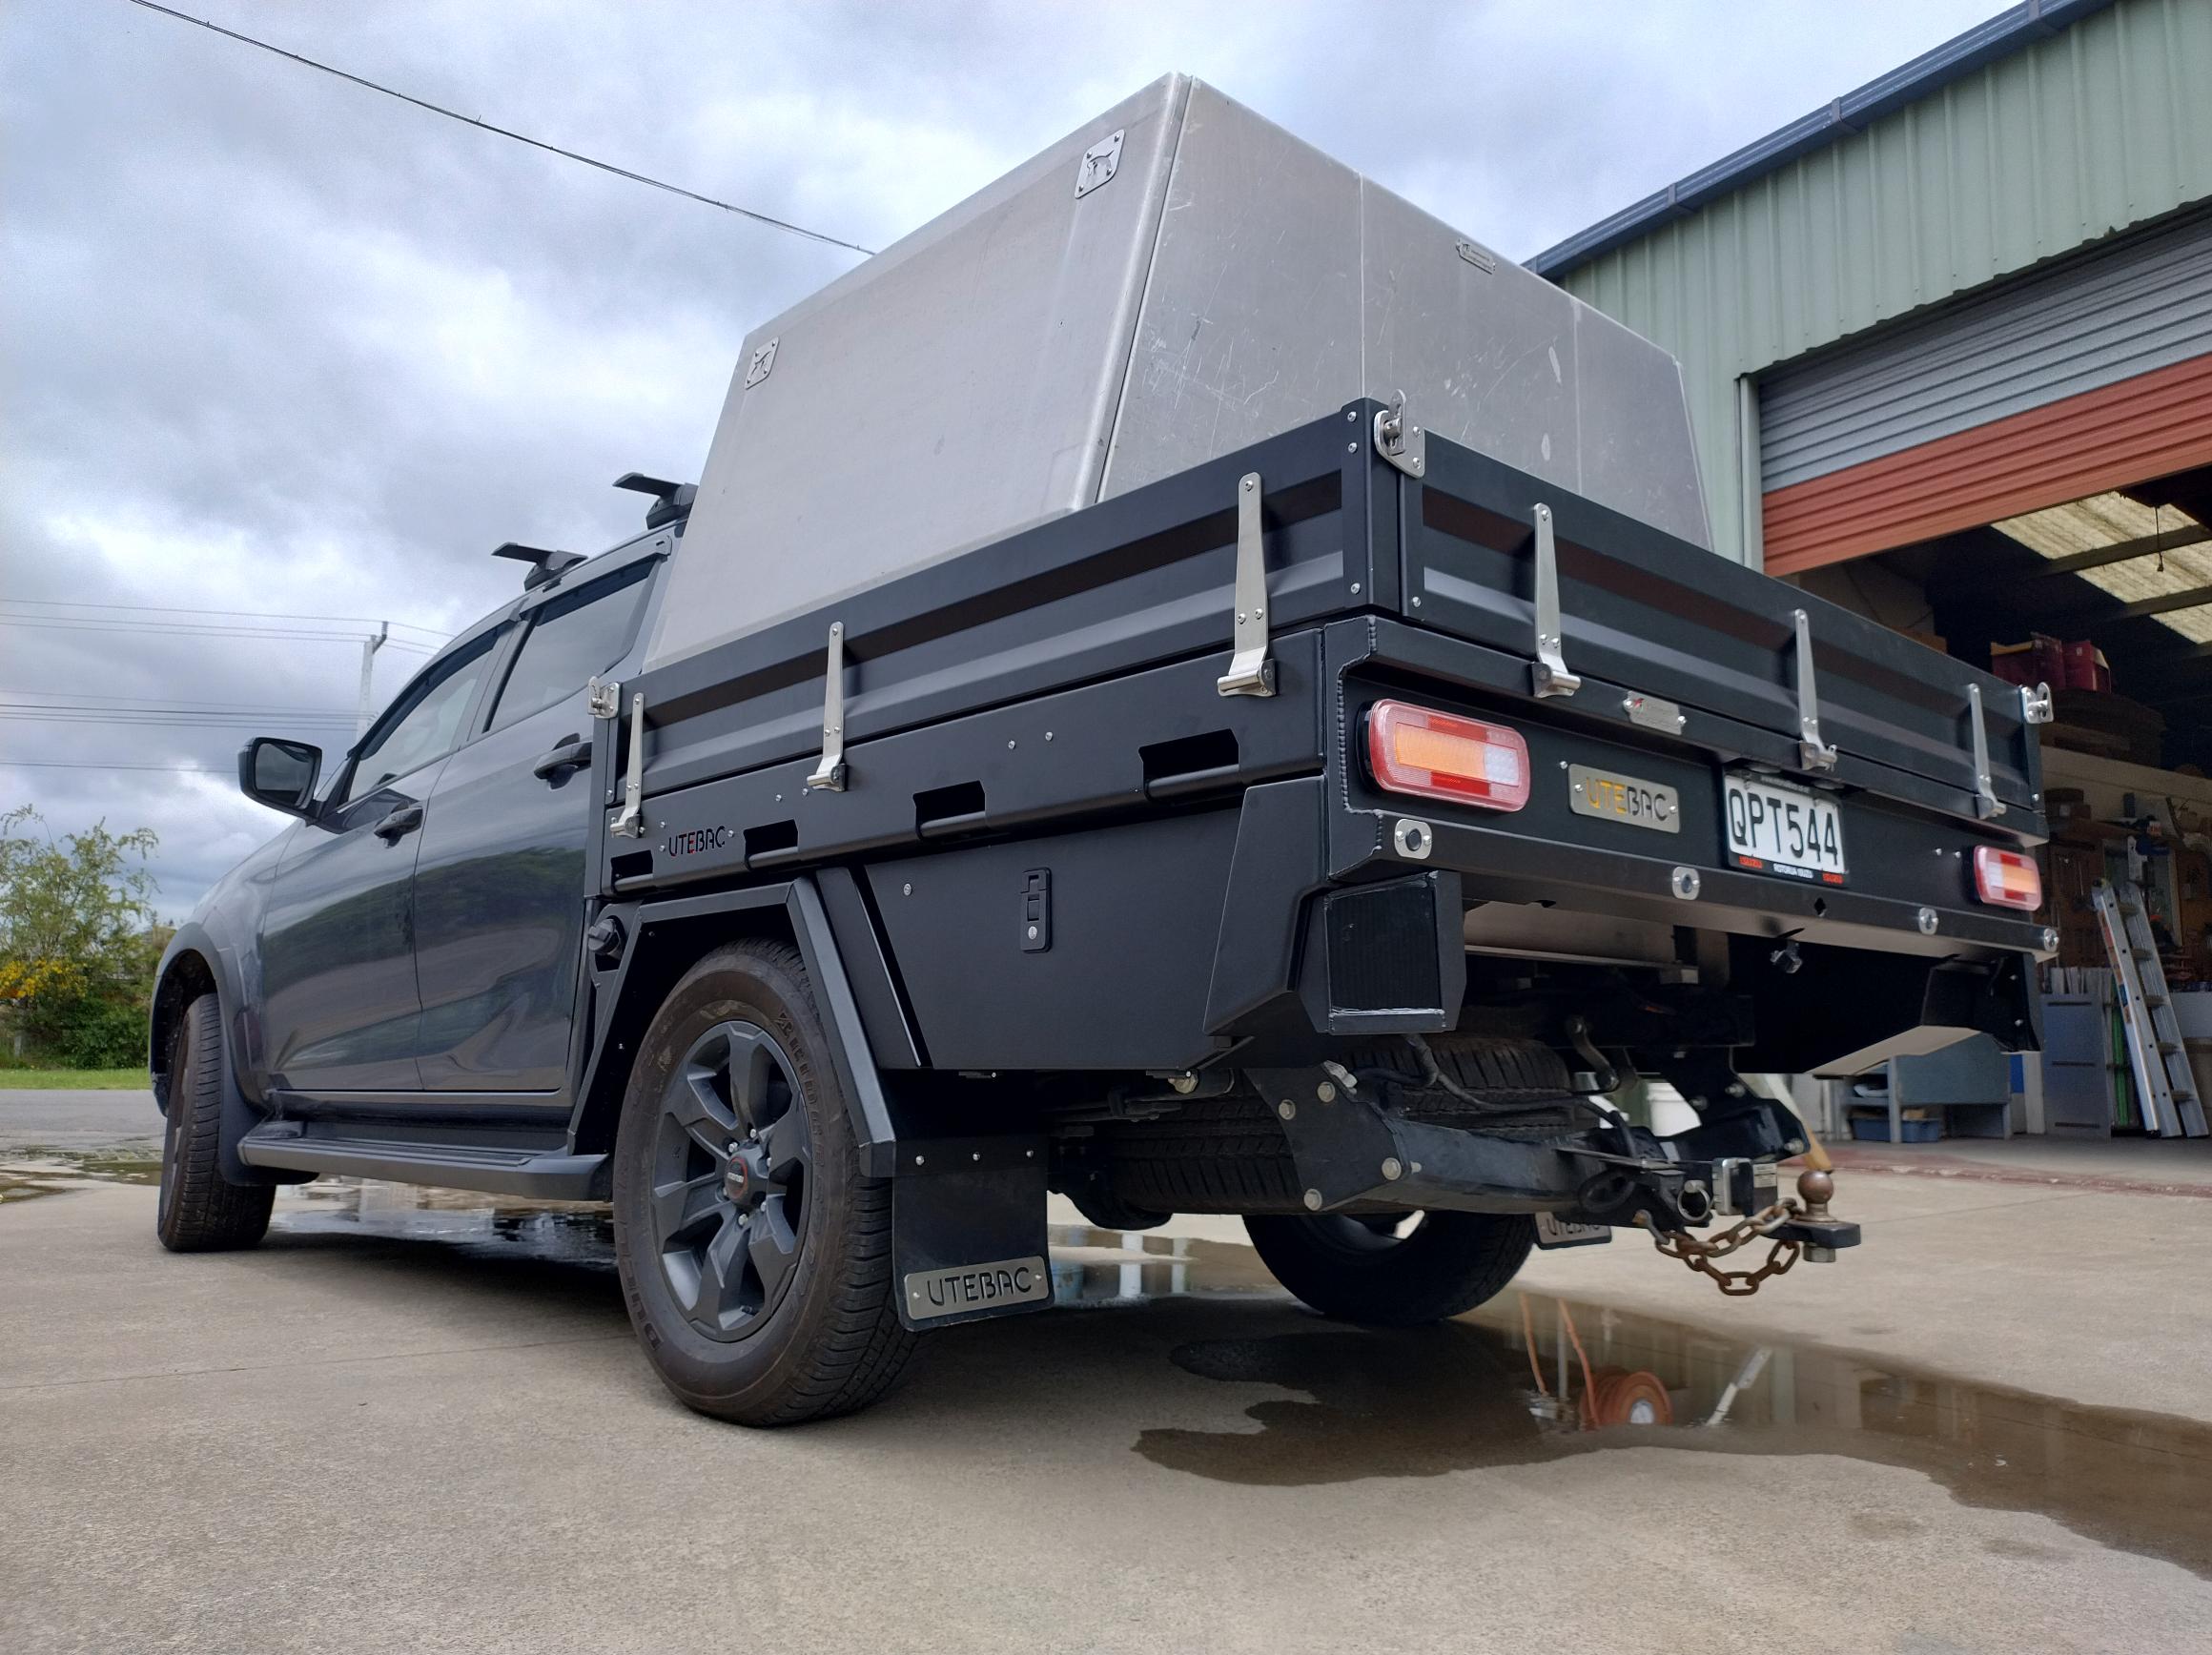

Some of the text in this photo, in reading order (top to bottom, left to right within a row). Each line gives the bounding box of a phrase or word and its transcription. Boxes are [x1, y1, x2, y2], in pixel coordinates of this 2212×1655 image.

[1586, 777, 1668, 821] UTEBAC
[668, 826, 726, 856] UTEBAC
[1729, 788, 1838, 866] QPT544
[927, 1267, 1032, 1306] UTEBAC
